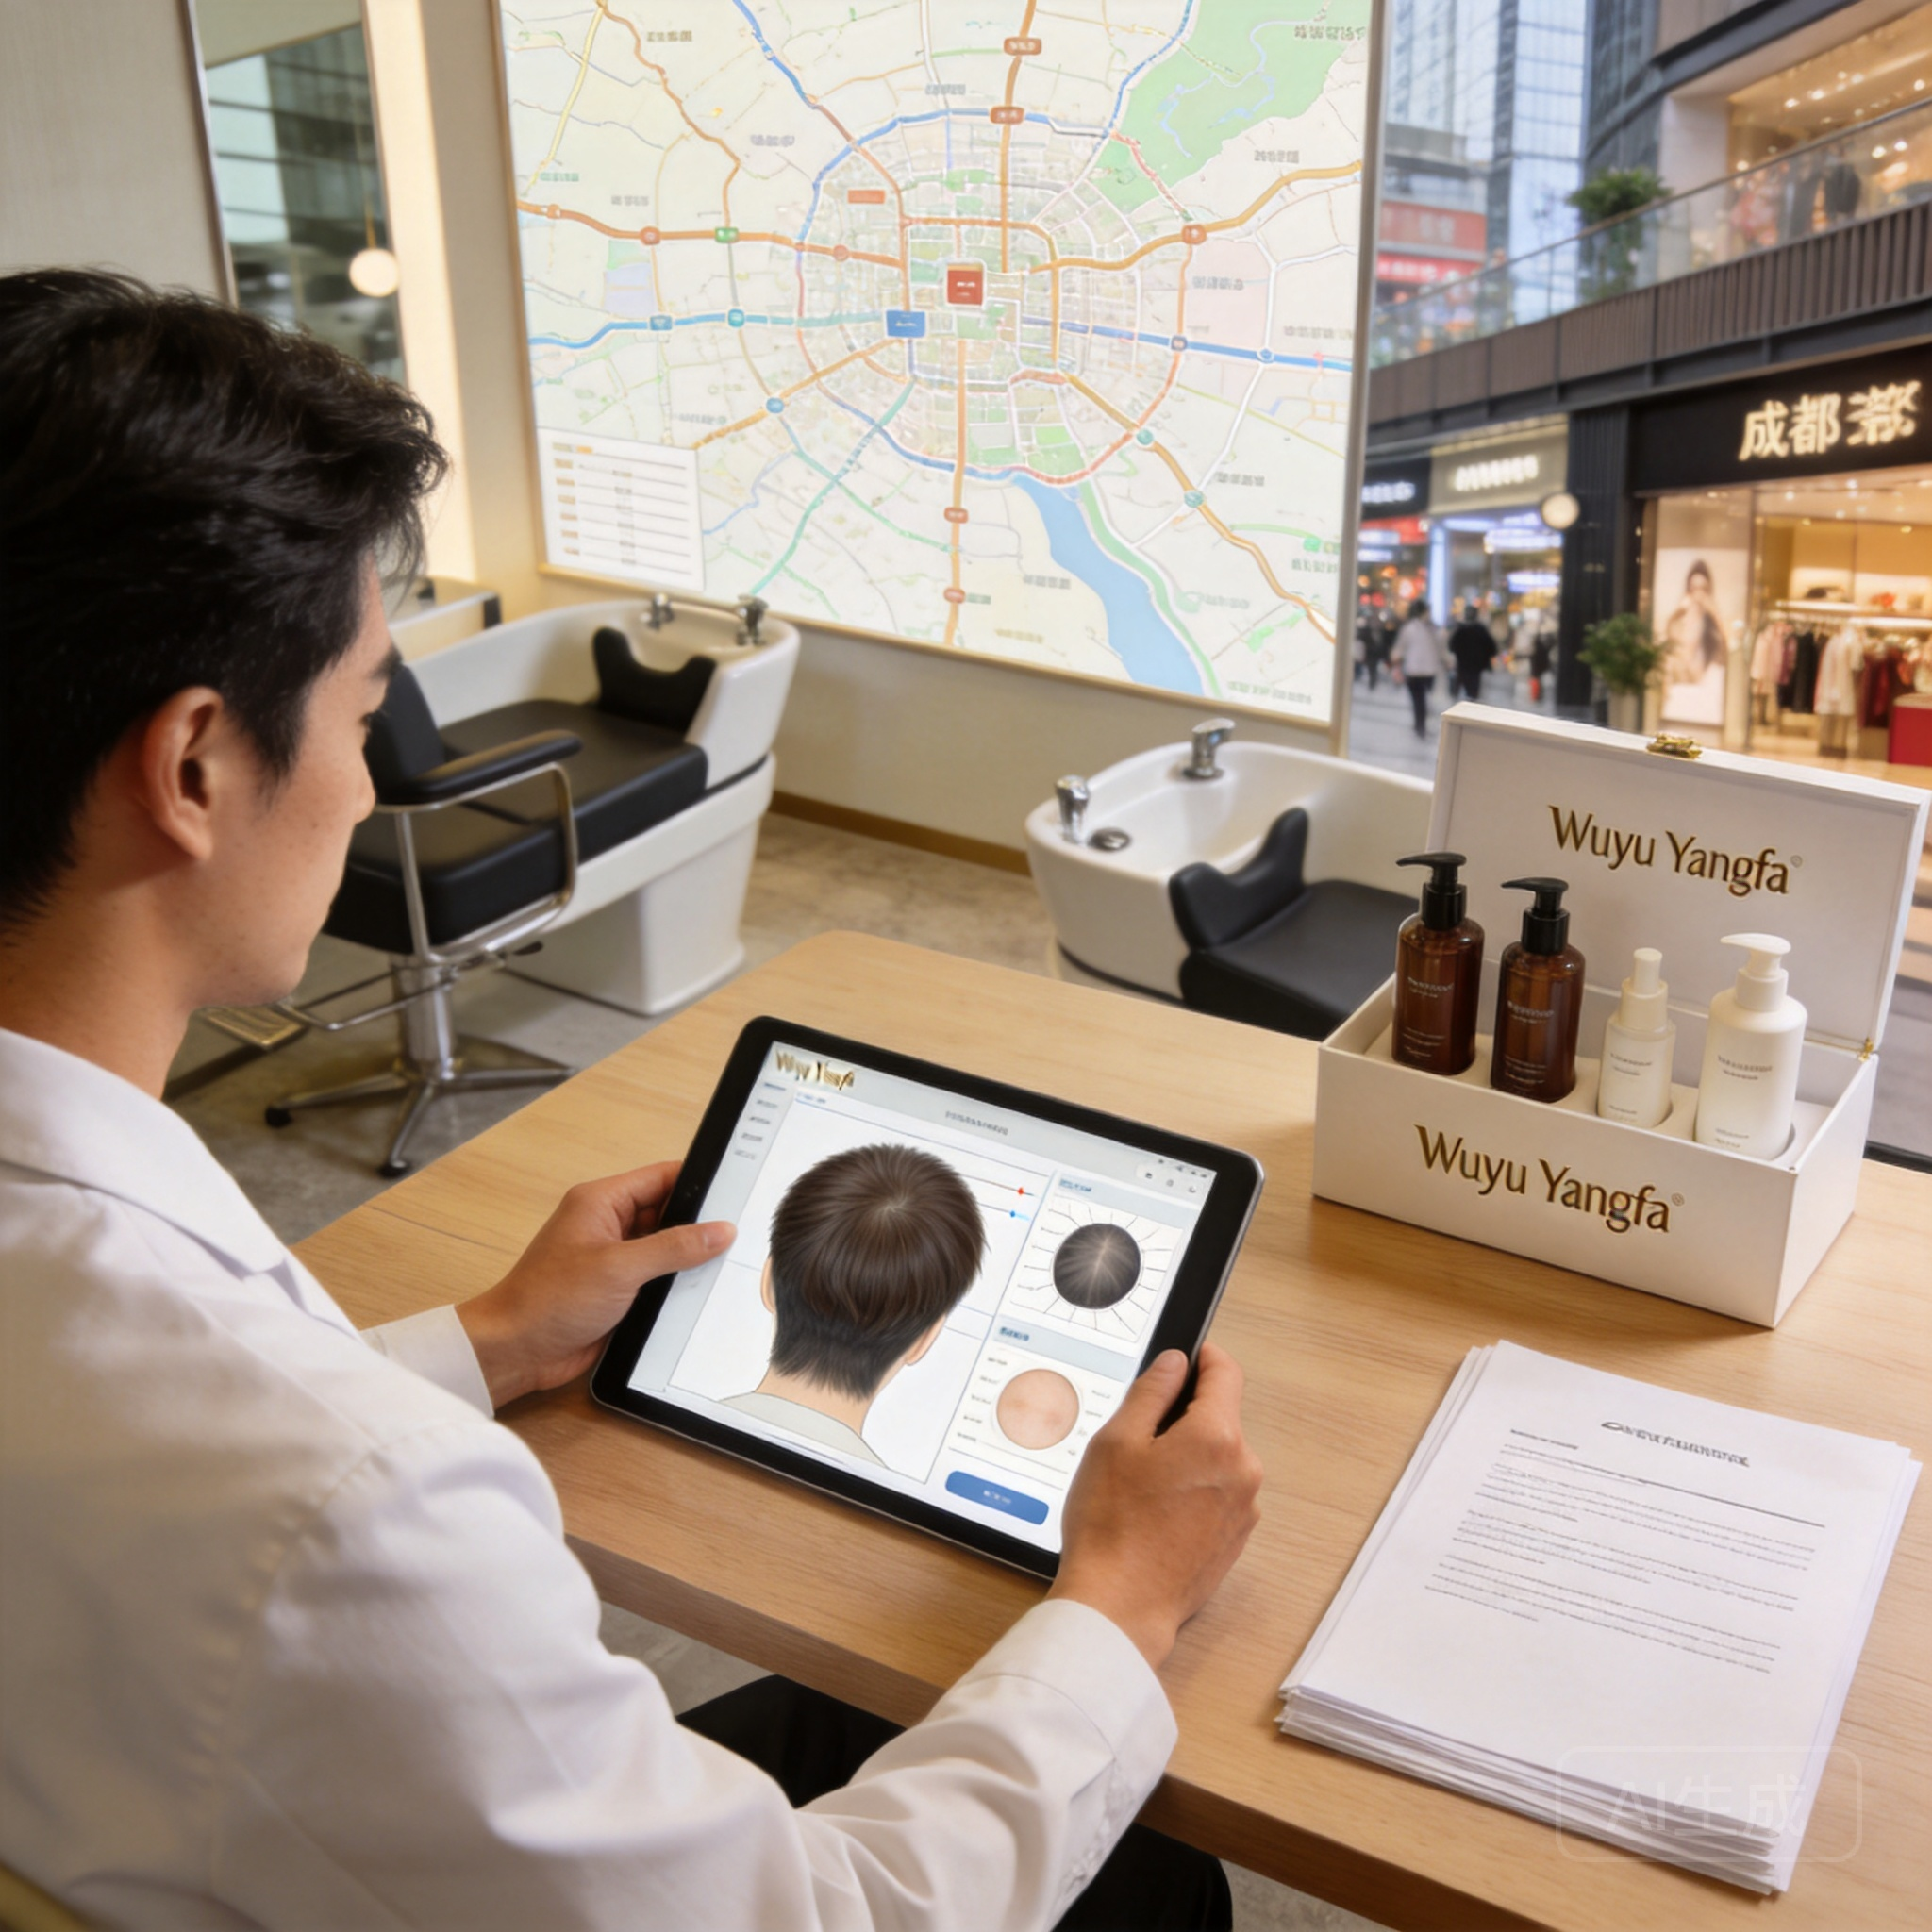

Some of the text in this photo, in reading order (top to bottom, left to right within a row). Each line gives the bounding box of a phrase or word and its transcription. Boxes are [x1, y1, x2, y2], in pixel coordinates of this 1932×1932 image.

[1547, 804, 1790, 898] Wuyu Yangfa
[1413, 1123, 1671, 1234] Wuyu Yangfa
